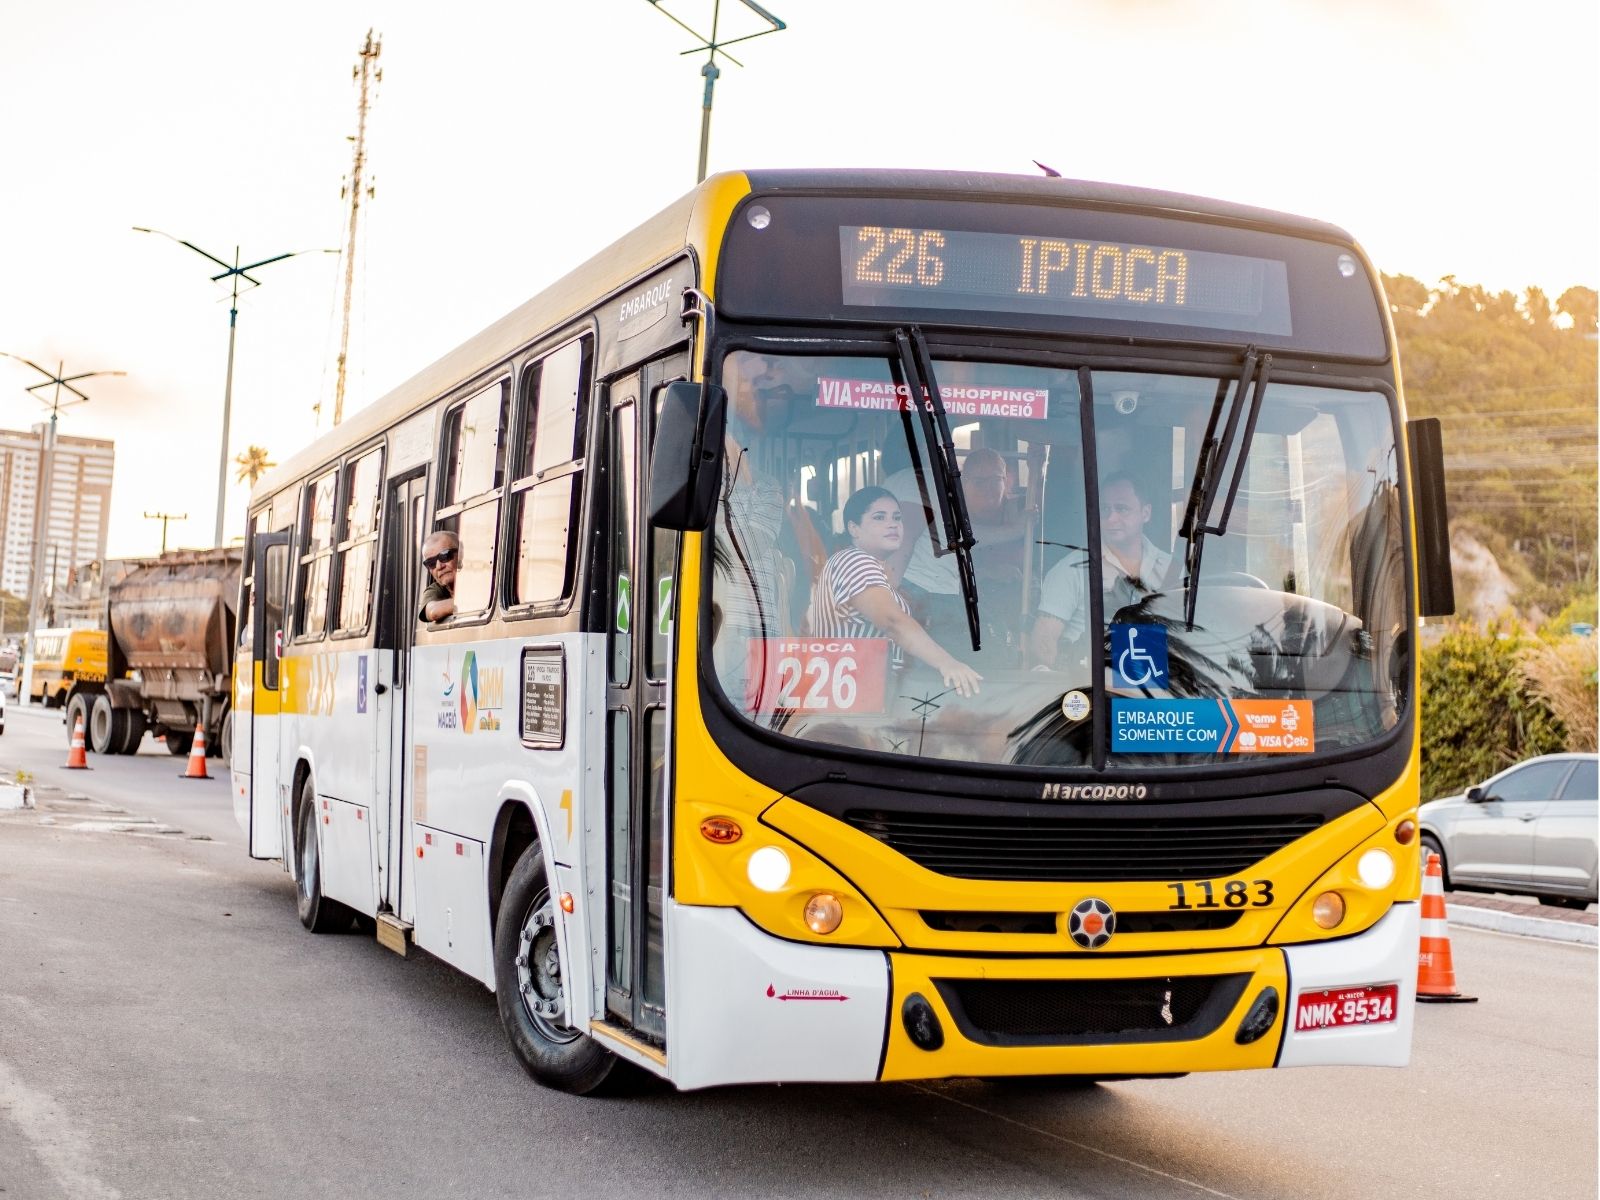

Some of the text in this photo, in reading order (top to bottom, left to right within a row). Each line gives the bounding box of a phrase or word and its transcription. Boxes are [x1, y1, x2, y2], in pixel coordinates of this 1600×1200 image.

[856, 225, 1189, 305] 226 IPIOCA
[620, 278, 673, 322] EMBARQUE
[821, 380, 852, 406] VIA
[860, 382, 931, 397] PARQ
[940, 387, 1035, 402] SHOPPING
[860, 398, 895, 409] UNIT
[905, 400, 976, 414] SOPING
[980, 401, 1033, 418] MACEIÓ
[779, 642, 856, 653] IPIOCA
[775, 656, 858, 709] 226
[437, 709, 457, 729] MACEIÓ
[1117, 711, 1195, 726] EMBARQUE
[1118, 729, 1217, 742] SOMENTE COM
[1259, 735, 1282, 748] VISA
[1167, 879, 1275, 910] 1183
